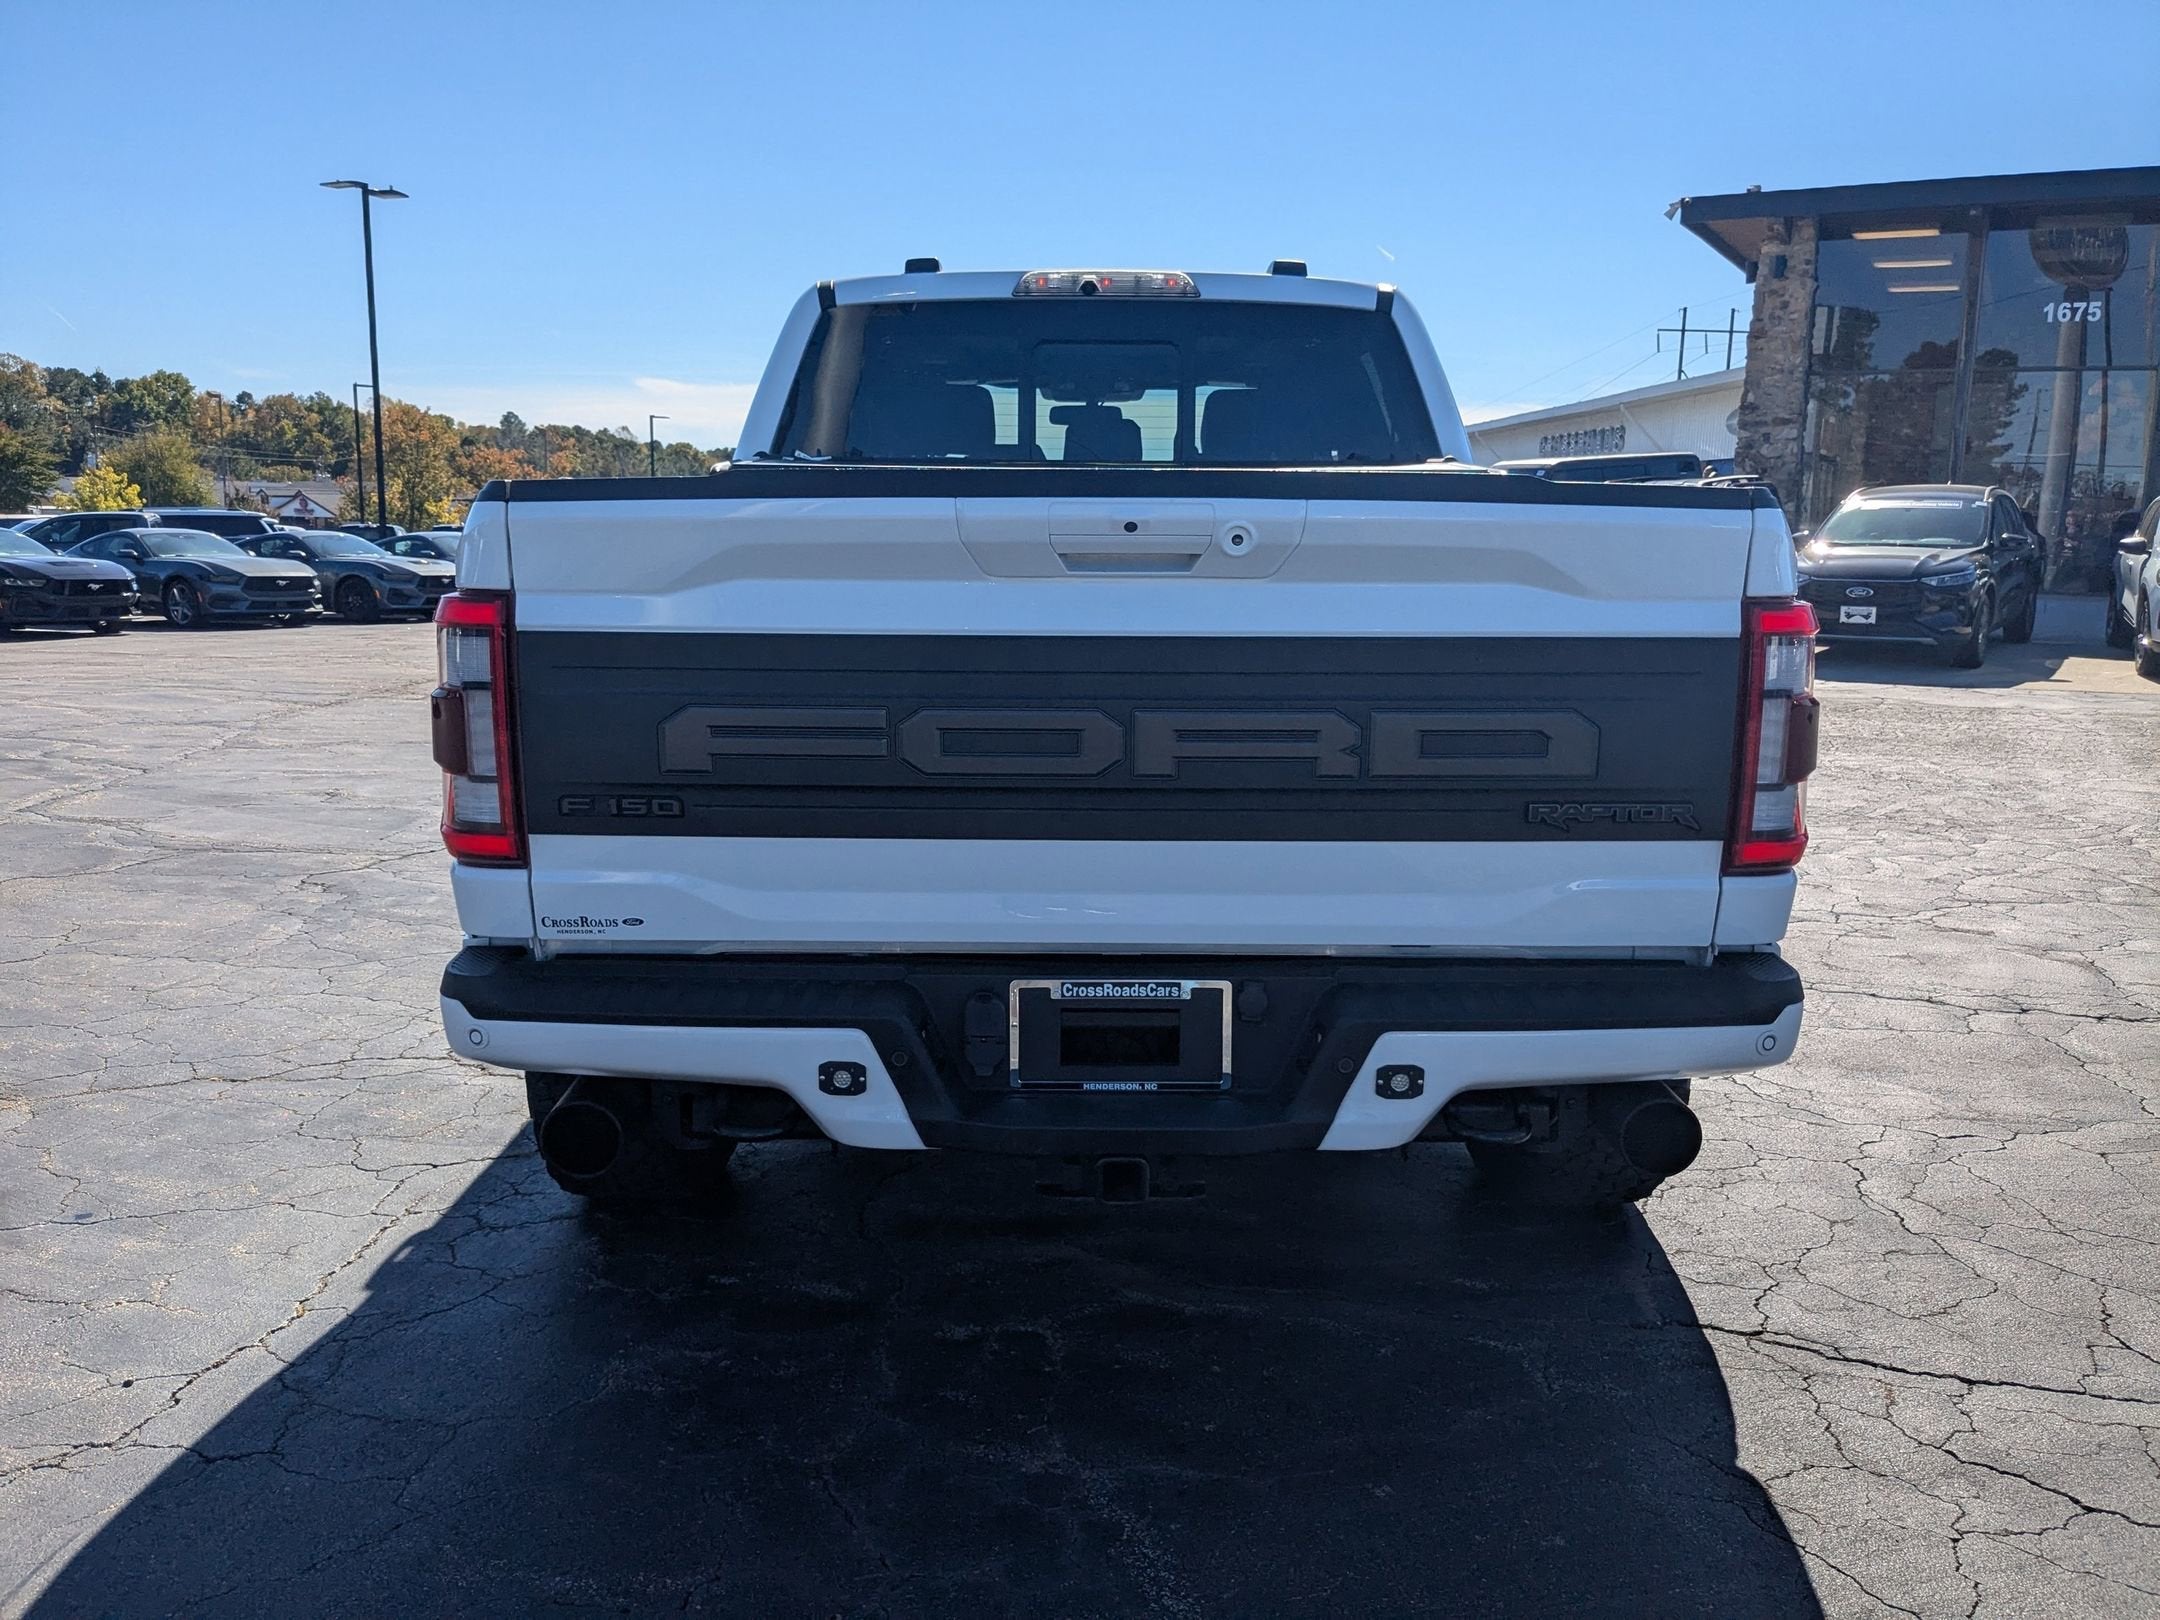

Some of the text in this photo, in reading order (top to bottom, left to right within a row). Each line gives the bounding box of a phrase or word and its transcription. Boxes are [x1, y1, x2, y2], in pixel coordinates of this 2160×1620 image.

[2043, 301, 2102, 323] 1675
[656, 703, 1600, 780] FORD
[560, 796, 684, 817] F 150
[1527, 803, 1700, 831] RAPTOR
[1062, 983, 1180, 997] CrossRoadsCars
[1144, 1083, 1158, 1091] NC
